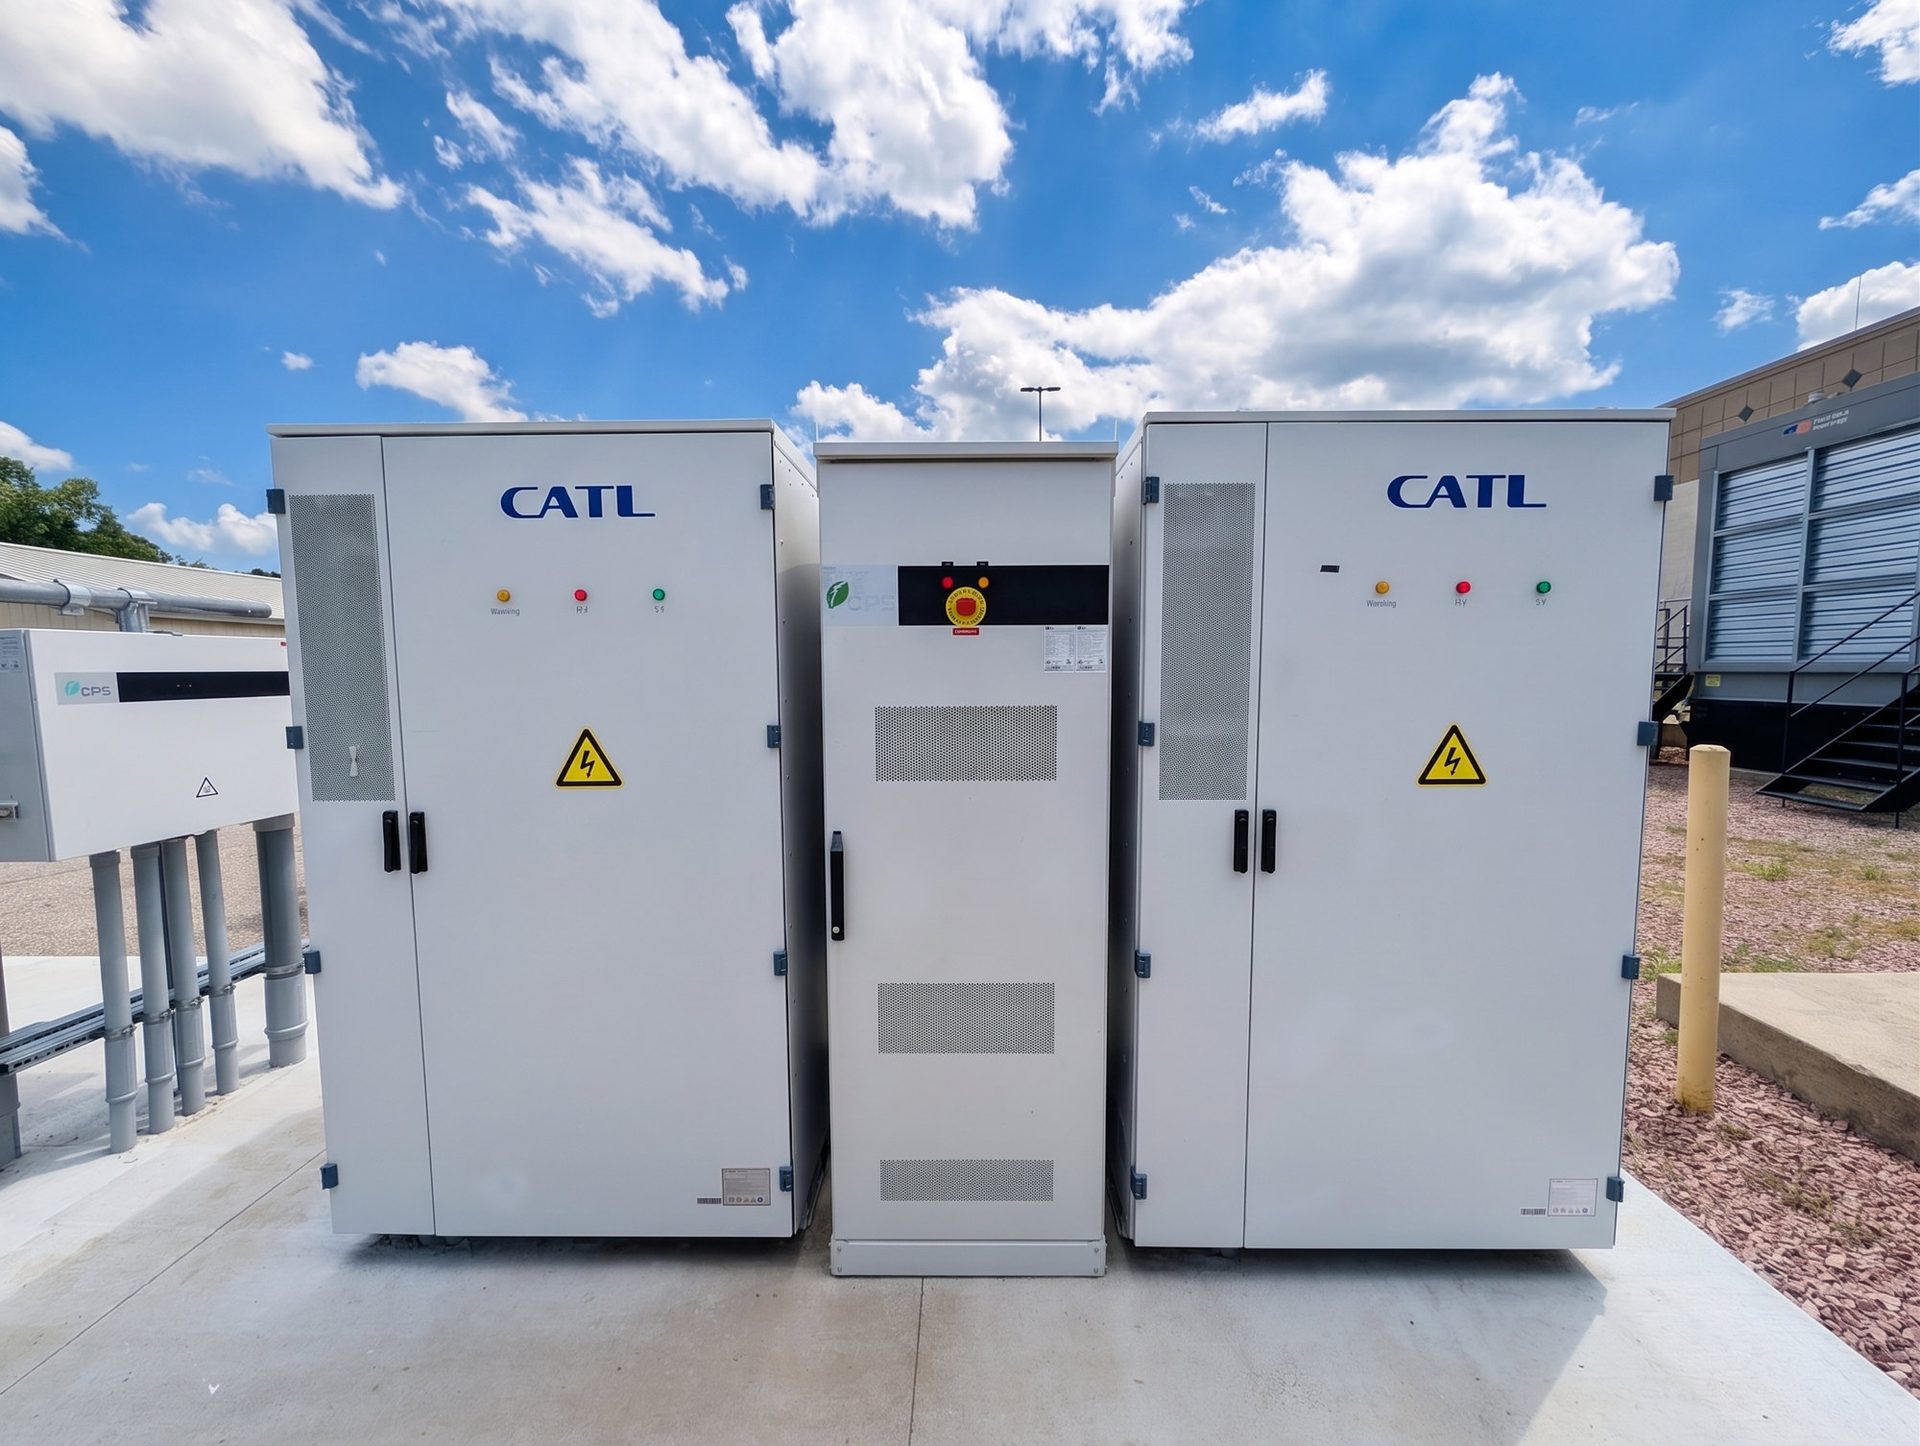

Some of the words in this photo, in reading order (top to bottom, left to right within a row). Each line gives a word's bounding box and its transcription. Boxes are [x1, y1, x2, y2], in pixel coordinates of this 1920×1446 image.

[500, 485, 656, 518] CATL
[1387, 474, 1547, 508] CATL
[81, 686, 111, 696] CPS
